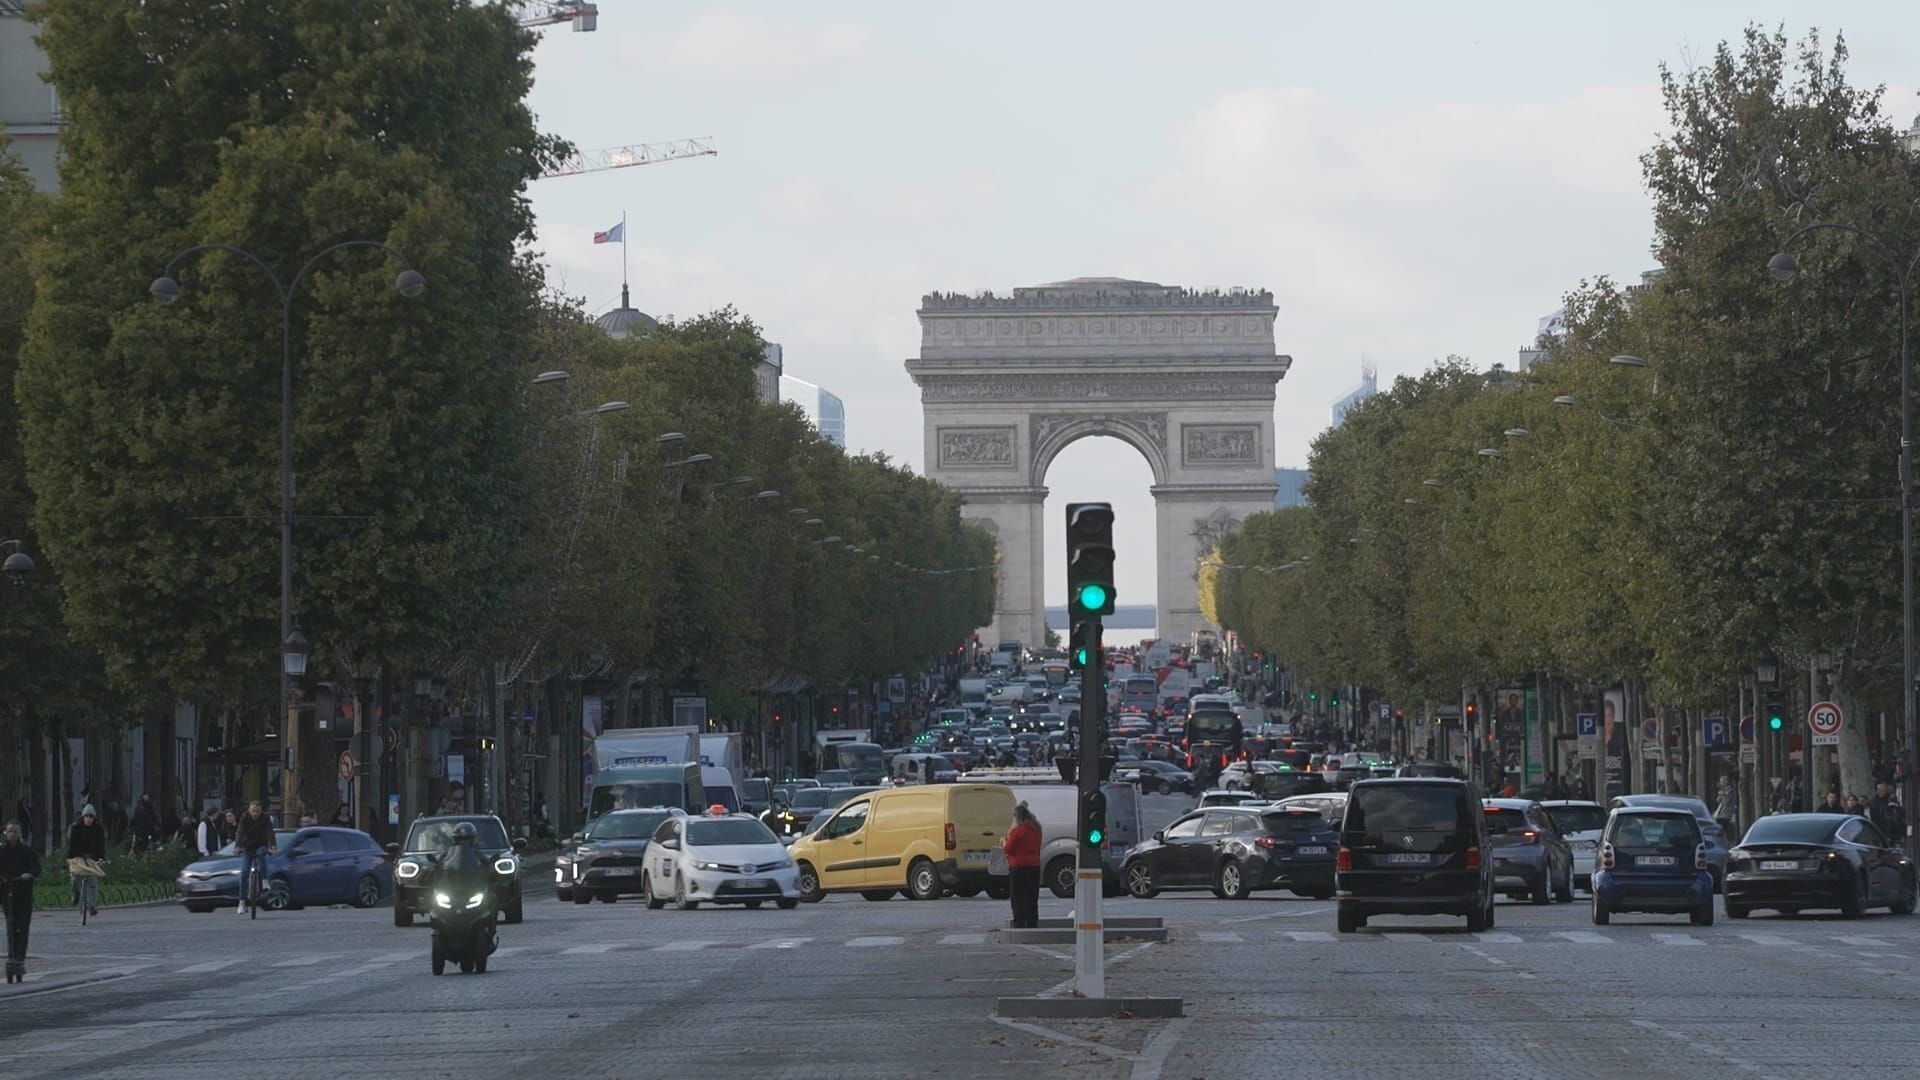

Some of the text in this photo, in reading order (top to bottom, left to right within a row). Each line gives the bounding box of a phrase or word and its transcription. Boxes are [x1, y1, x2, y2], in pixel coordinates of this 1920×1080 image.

[1583, 718, 1593, 733] P
[1816, 712, 1836, 726] 50
[1711, 724, 1724, 740] P
